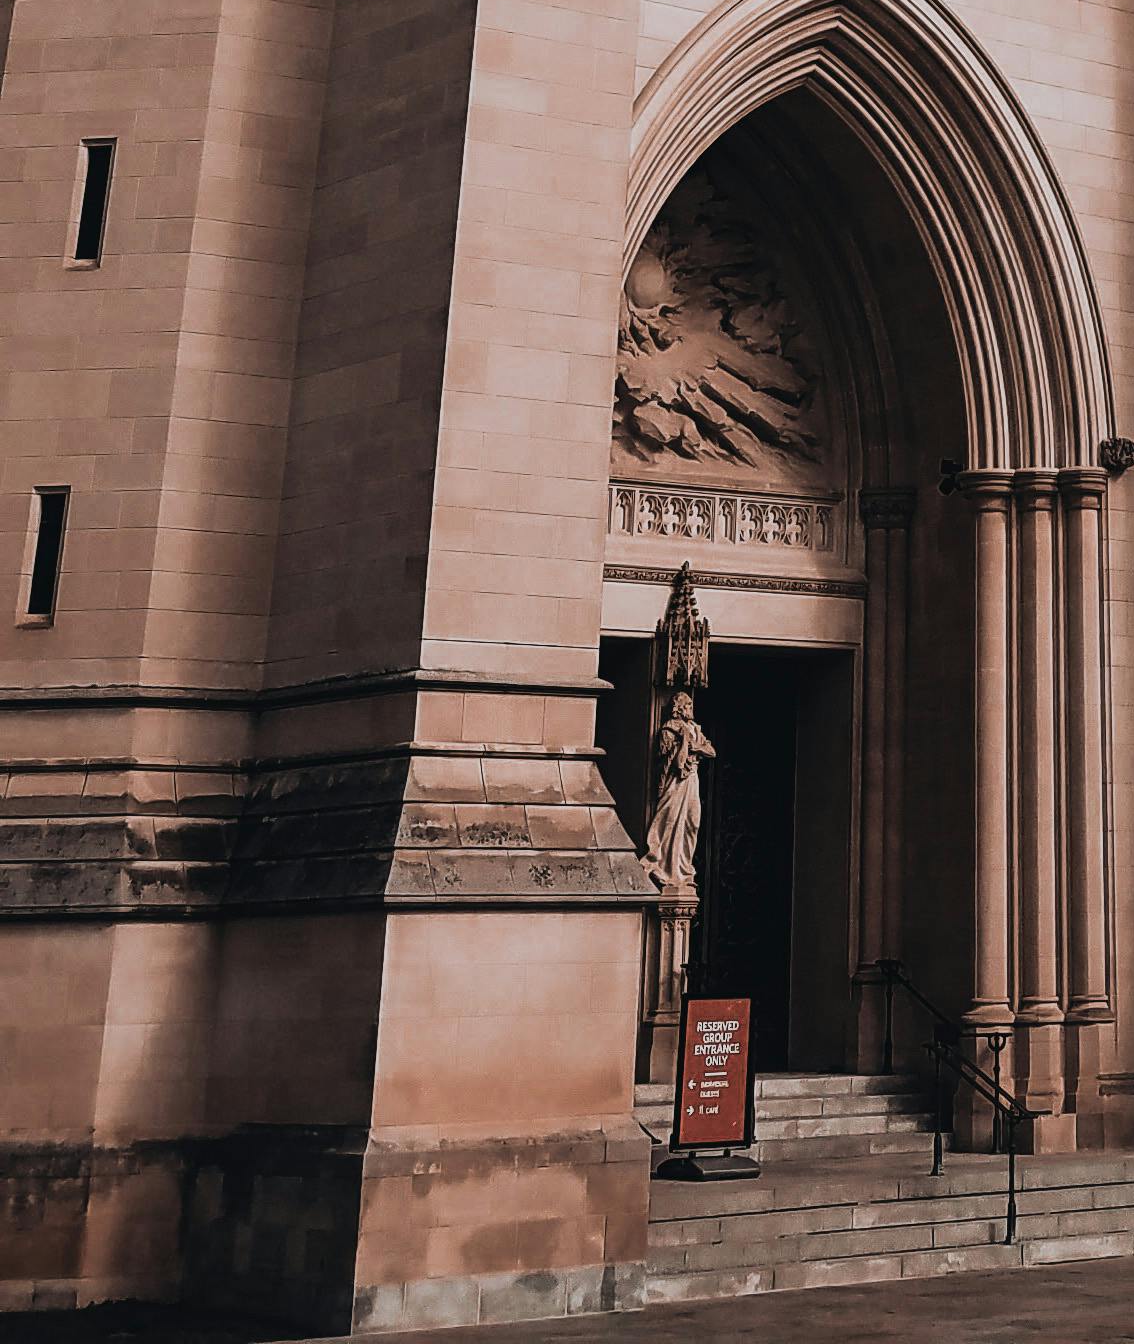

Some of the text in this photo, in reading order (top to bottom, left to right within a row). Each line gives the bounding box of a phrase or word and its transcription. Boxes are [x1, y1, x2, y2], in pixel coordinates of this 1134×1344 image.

[697, 1021, 739, 1032] RESERVED
[703, 1032, 732, 1043] GROUP
[694, 1043, 740, 1055] ENTRANCE
[705, 1055, 728, 1066] ONLY
